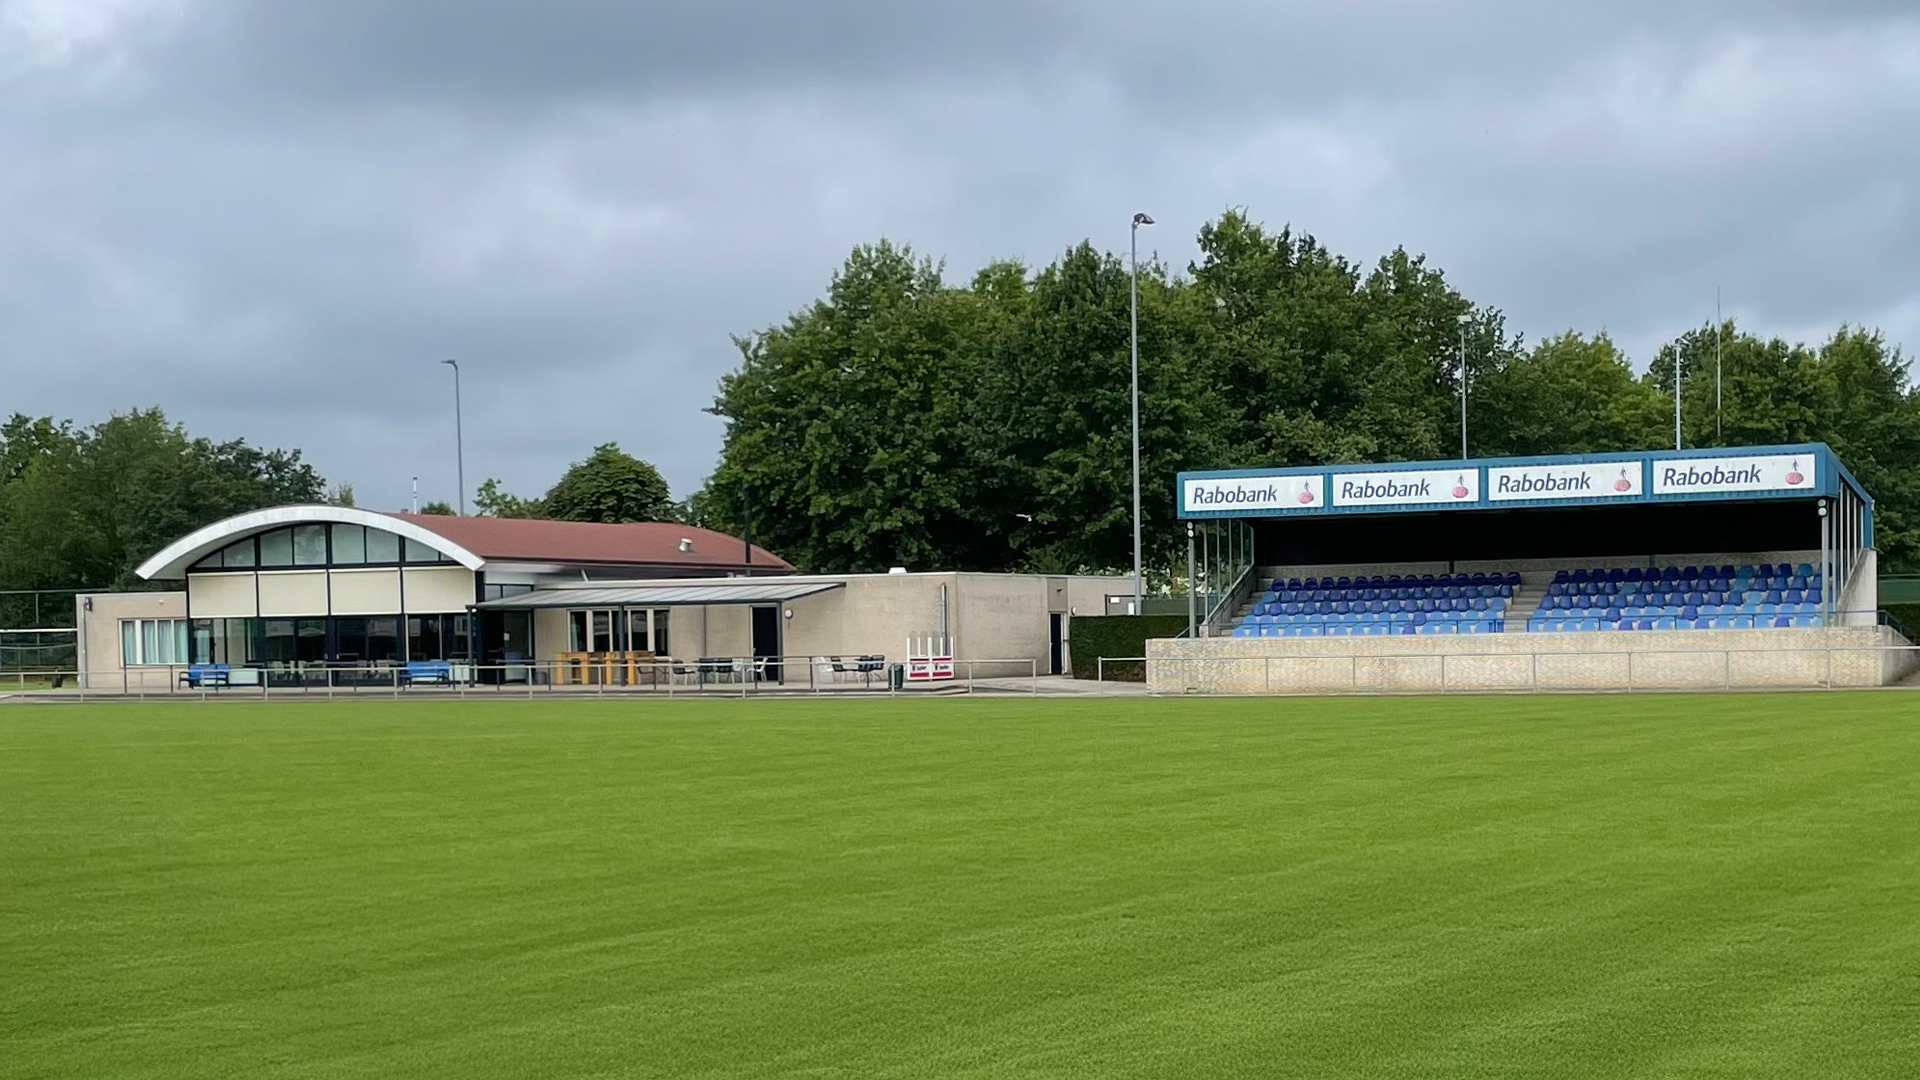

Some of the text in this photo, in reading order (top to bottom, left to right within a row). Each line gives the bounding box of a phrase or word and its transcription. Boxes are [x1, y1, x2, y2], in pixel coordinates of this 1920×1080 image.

[1498, 471, 1591, 493] Rabobank
[1663, 464, 1761, 487] Rabobank
[1193, 485, 1277, 504] Rabobank
[1341, 478, 1430, 499] Rabobank
